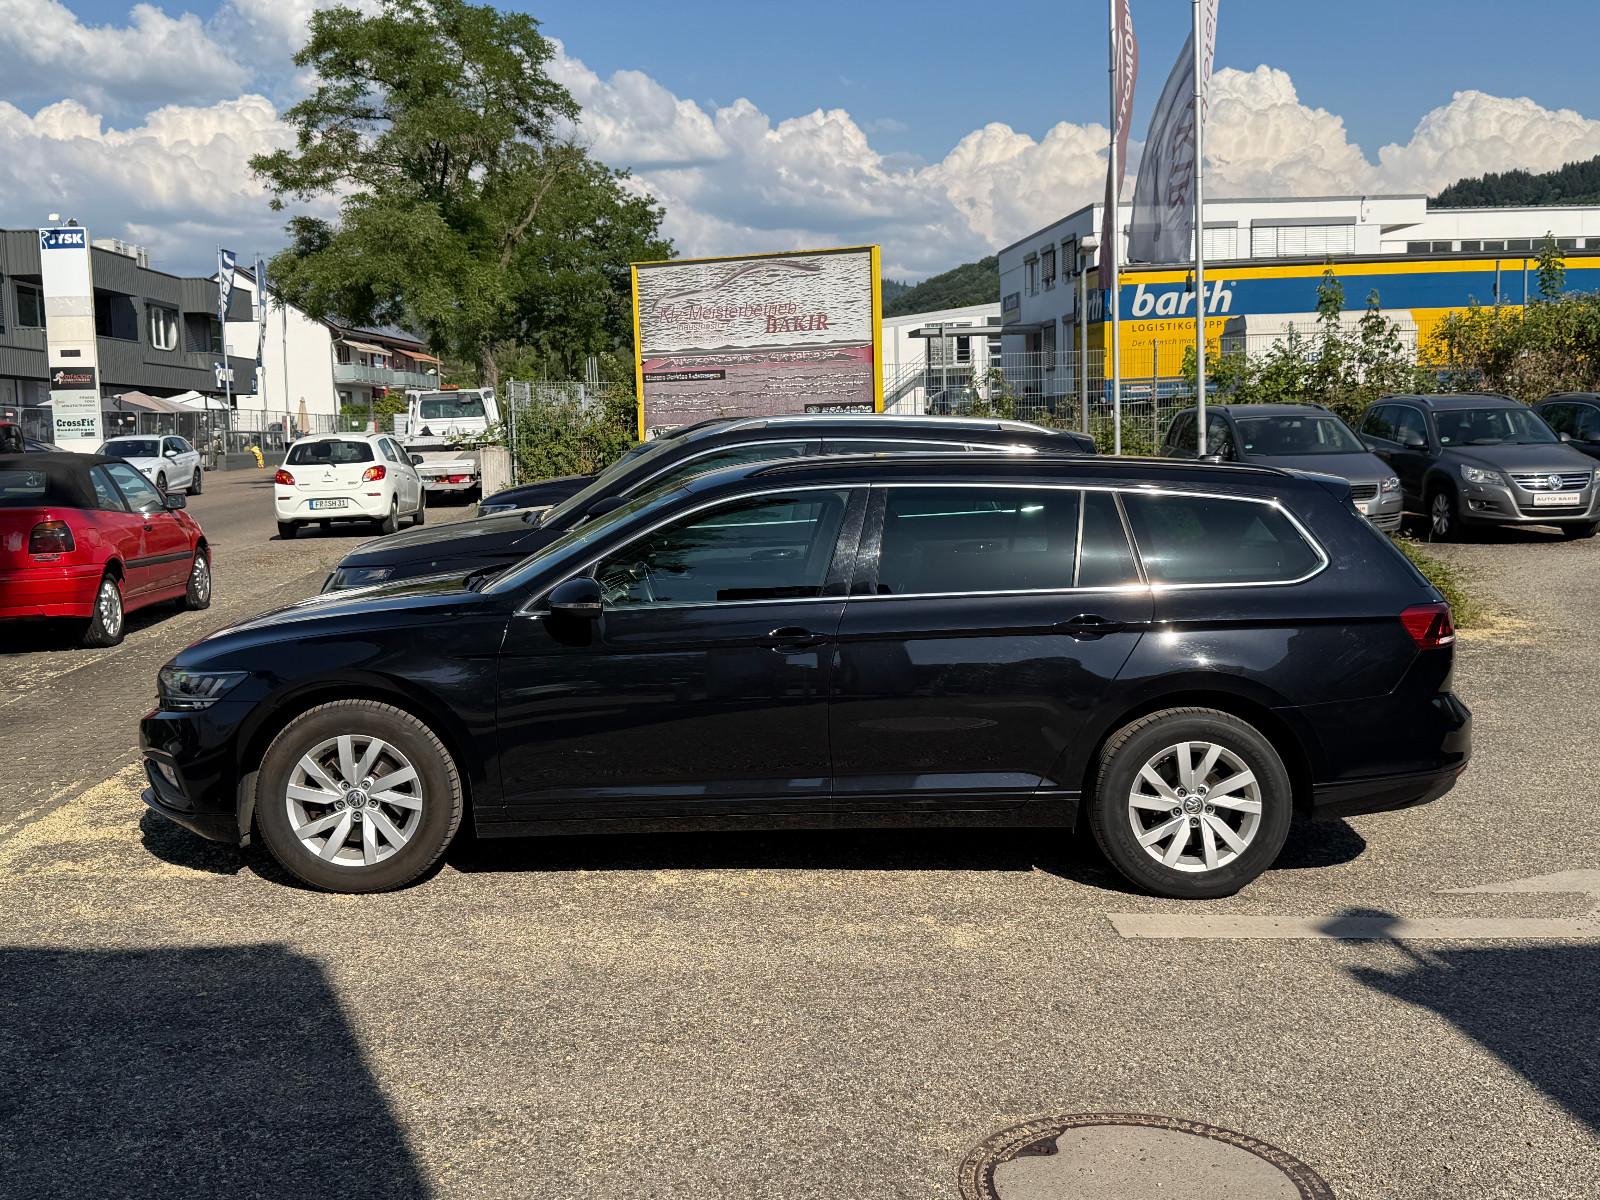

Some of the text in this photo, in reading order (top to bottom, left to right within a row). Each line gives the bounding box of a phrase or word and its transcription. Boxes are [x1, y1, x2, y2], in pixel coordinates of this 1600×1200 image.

[1113, 0, 1134, 143] UTOMOBI
[49, 233, 83, 244] JYSK
[1131, 280, 1233, 318] barth
[1076, 288, 1103, 324] brth
[765, 314, 829, 334] BAKIR
[1131, 320, 1222, 332] LOGISTIKGUPP
[1131, 339, 1146, 347] Der
[1148, 338, 1177, 346] Mnsch
[56, 418, 95, 428] CrossFit
[315, 500, 324, 508] FR
[337, 499, 345, 507] 31
